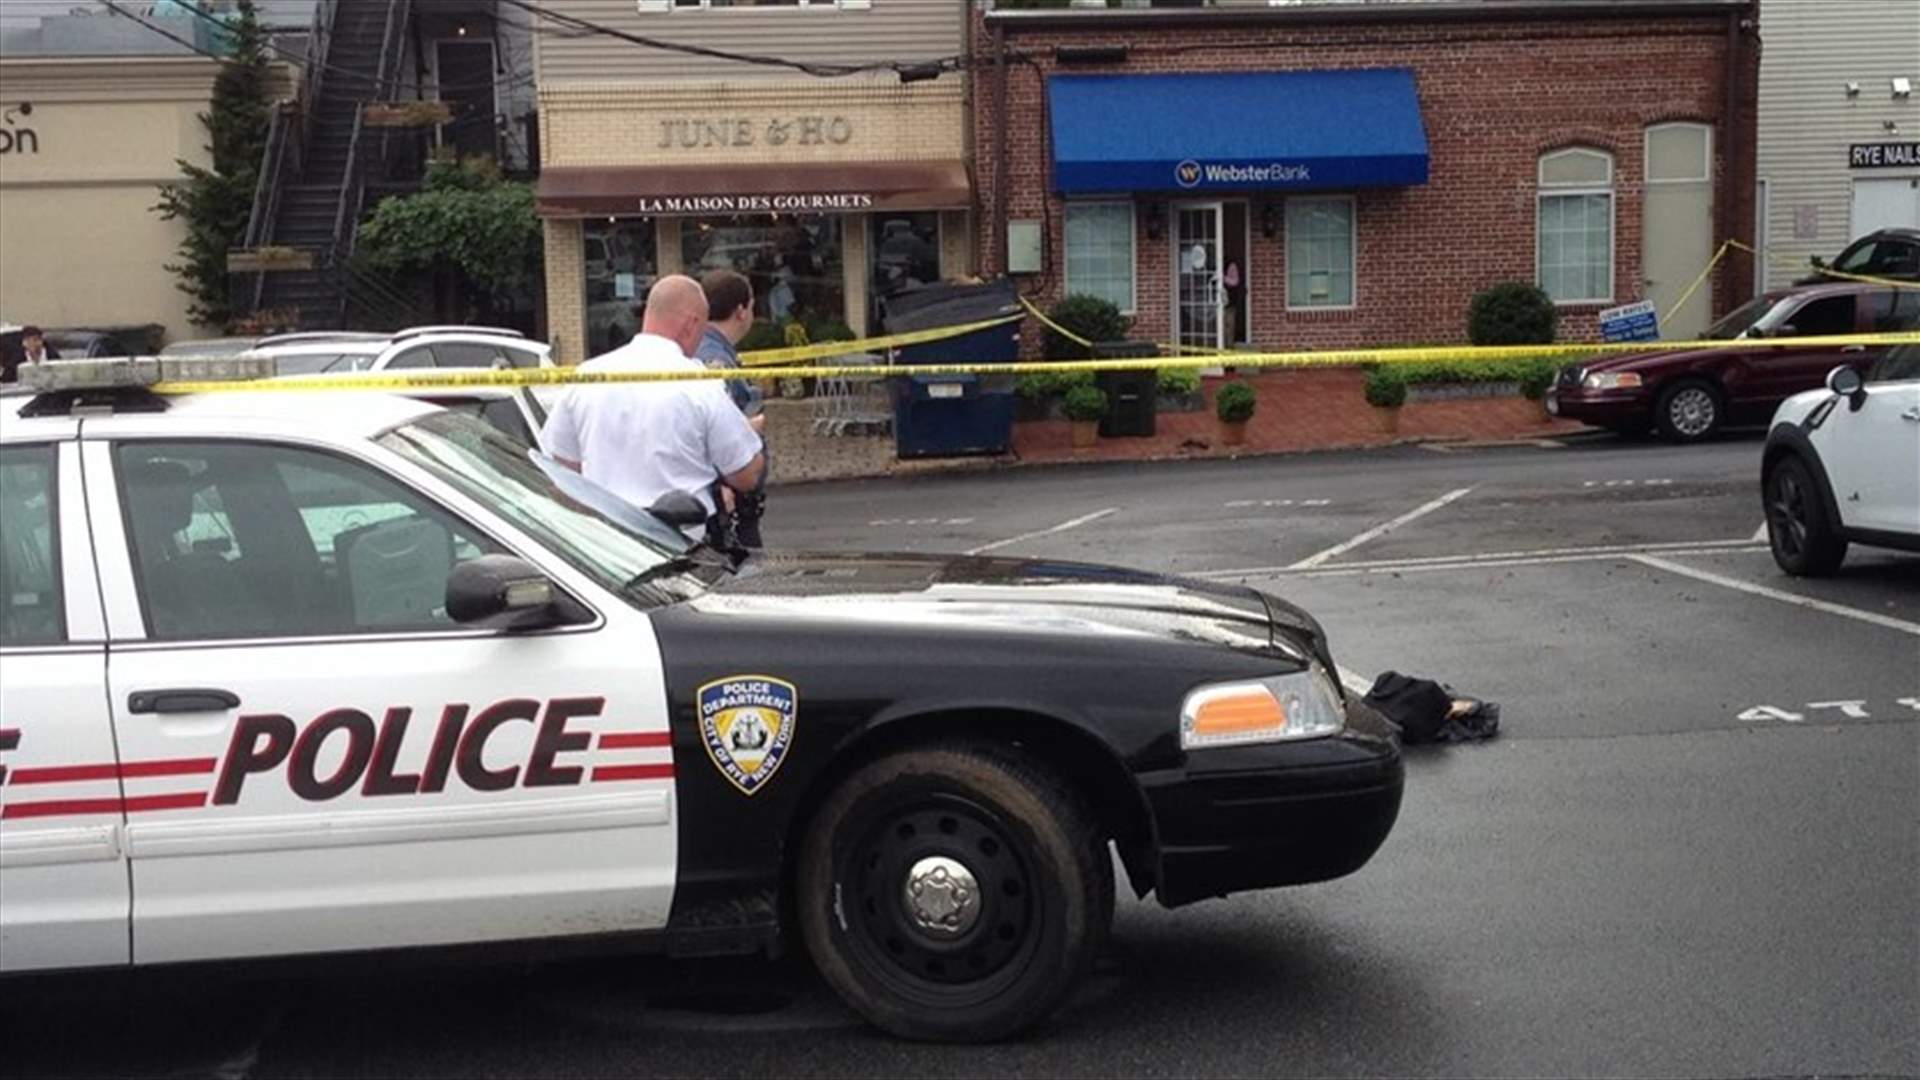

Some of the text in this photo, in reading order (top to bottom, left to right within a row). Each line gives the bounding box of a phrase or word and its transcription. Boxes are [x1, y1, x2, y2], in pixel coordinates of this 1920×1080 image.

[657, 115, 851, 148] JUNE & HO
[1852, 146, 1881, 165] RYE
[1205, 163, 1311, 181] WebsterBank
[639, 194, 872, 212] LA MAISON DES GOURMETS
[722, 682, 771, 695] POLICE
[703, 694, 791, 715] DEPARTMENT
[211, 696, 606, 807] POLICE
[704, 716, 720, 746] CITY
[714, 747, 731, 763] OF
[726, 763, 750, 785] RYE
[751, 754, 777, 782] NEW
